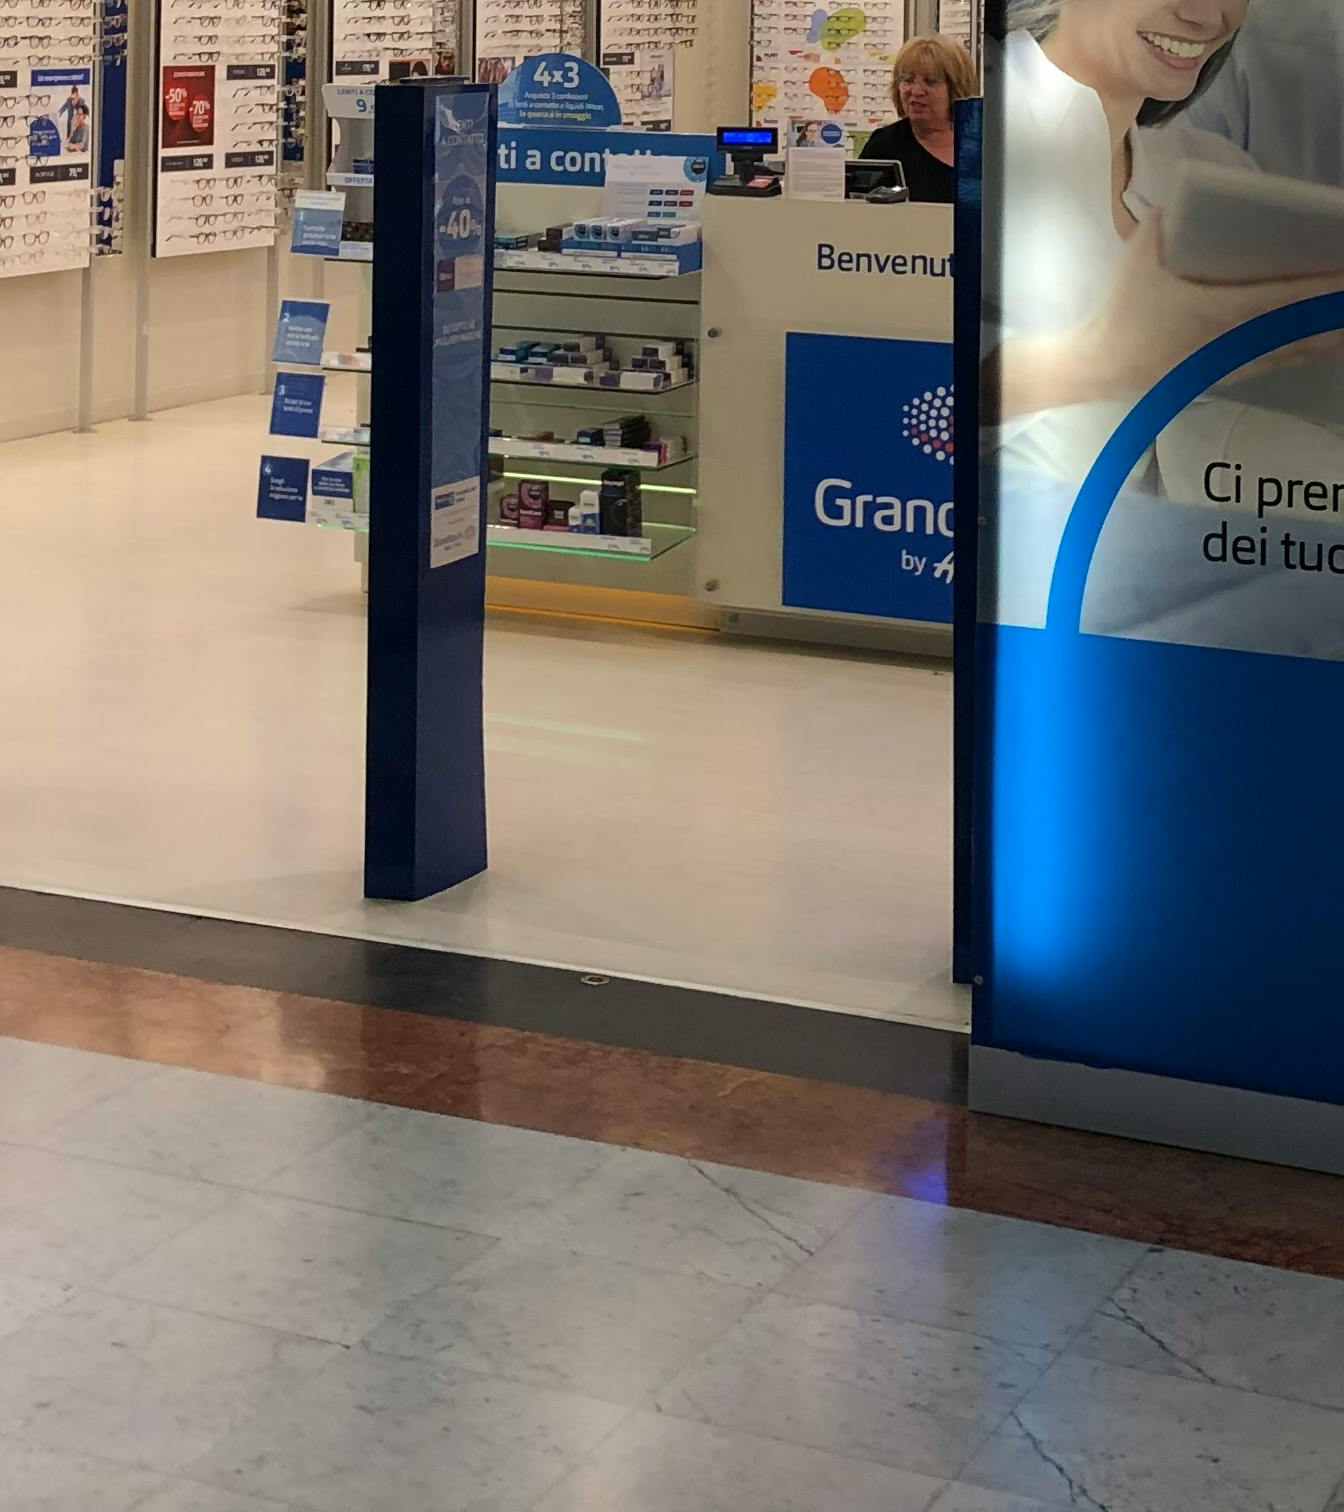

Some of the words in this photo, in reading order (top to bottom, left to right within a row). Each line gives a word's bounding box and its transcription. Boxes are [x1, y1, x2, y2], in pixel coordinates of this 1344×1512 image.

[532, 60, 581, 89] 4x3
[525, 148, 541, 171] a
[439, 208, 482, 240] -40%
[817, 242, 954, 278] Benvenut
[1203, 460, 1243, 504] Ci
[1202, 520, 1268, 567] dei
[901, 548, 927, 576] by
